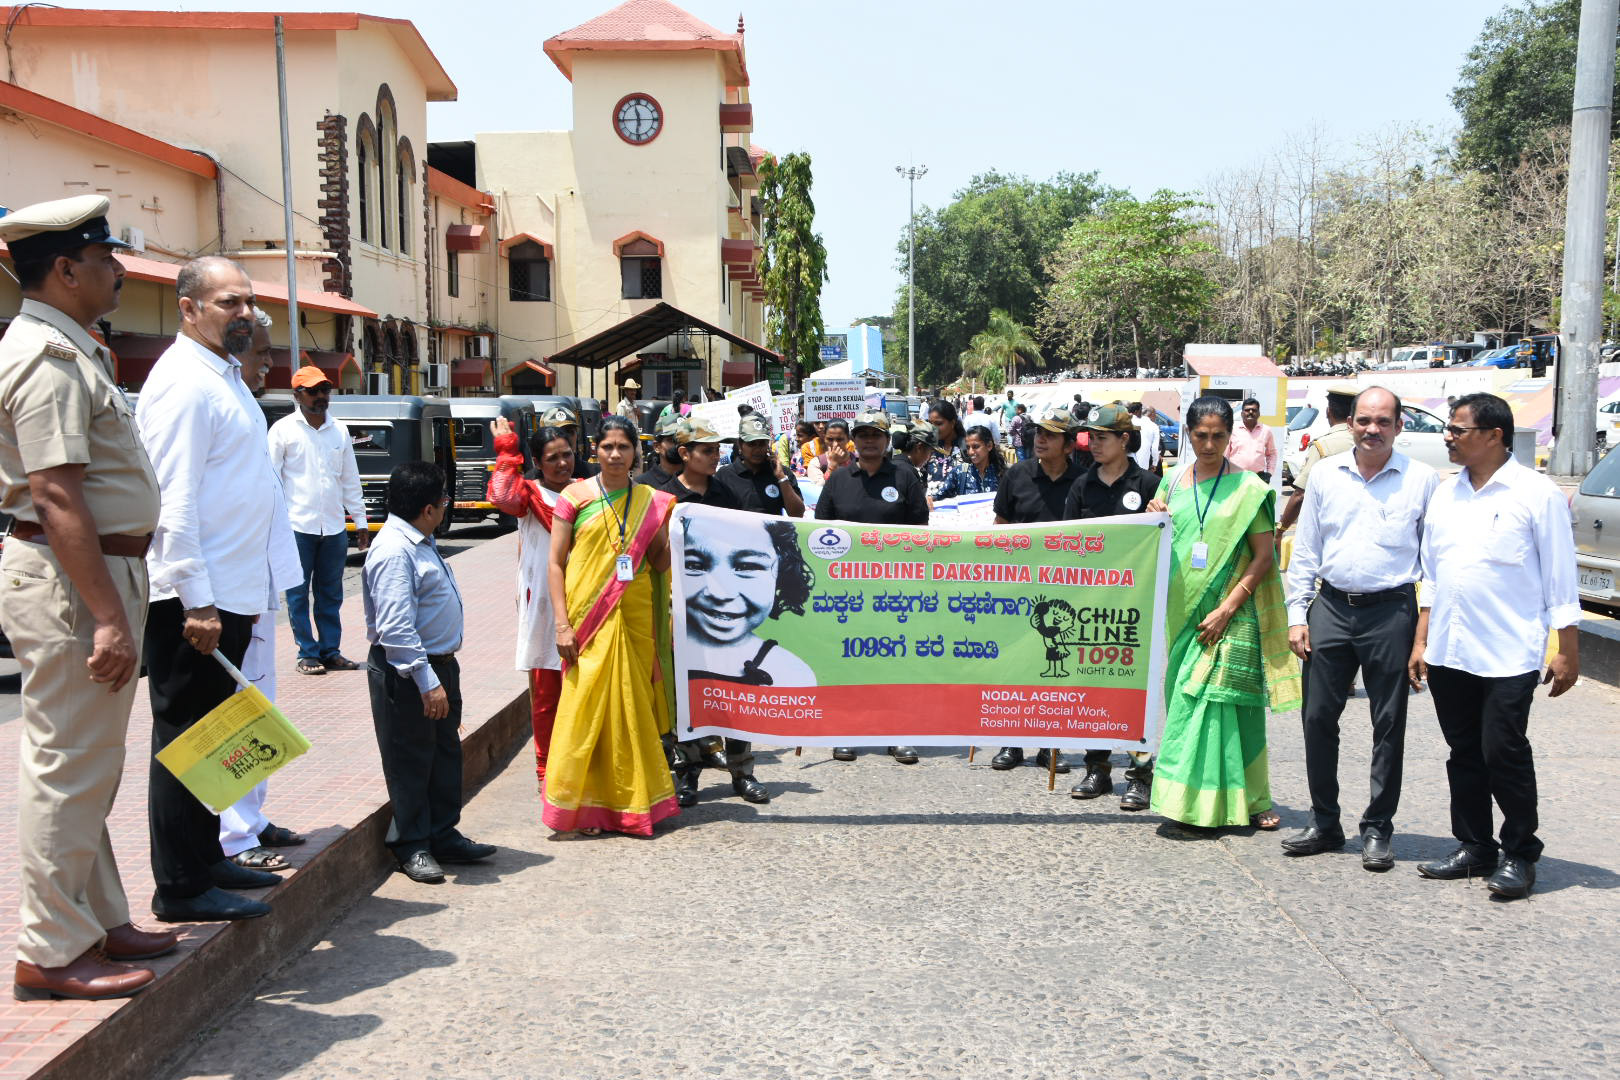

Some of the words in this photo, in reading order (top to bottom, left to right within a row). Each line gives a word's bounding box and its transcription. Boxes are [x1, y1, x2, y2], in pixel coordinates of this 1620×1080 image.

[751, 395, 762, 404] NO
[824, 395, 842, 403] CHILD
[843, 394, 865, 402] SEXUAL
[843, 403, 860, 411] KILLS
[817, 411, 856, 420] CHILDHOOD
[1044, 530, 1104, 556] ಕನ್ನಡ
[828, 561, 925, 580] CHILDLINE
[932, 562, 1032, 583] DAKSHINA
[1038, 566, 1135, 587] KANNADA
[813, 589, 864, 624] ಮಕ್ಕಳ
[873, 589, 939, 624] ಹಕ್ಕುಗಳ
[1077, 607, 1140, 625] CHILD
[1077, 625, 1138, 642] LINE
[915, 634, 945, 657] ಕರೆ
[953, 635, 999, 659] ಮಾಡಿ
[1077, 646, 1134, 666] 1098
[1077, 667, 1106, 675] NIGHT
[1108, 667, 1115, 675] &
[1117, 668, 1136, 677] DAY
[703, 687, 756, 703] COLLAB
[759, 694, 816, 706] AGENCY
[981, 691, 1027, 701] NODAL
[1030, 691, 1086, 702] AGENCY
[739, 704, 823, 719] MANGALORE
[980, 704, 1020, 714] School
[1023, 705, 1036, 714] of
[1038, 705, 1073, 716] Social
[1077, 706, 1110, 718] Work,
[980, 717, 1020, 728] Roshni
[1067, 719, 1129, 732] Mangalore
